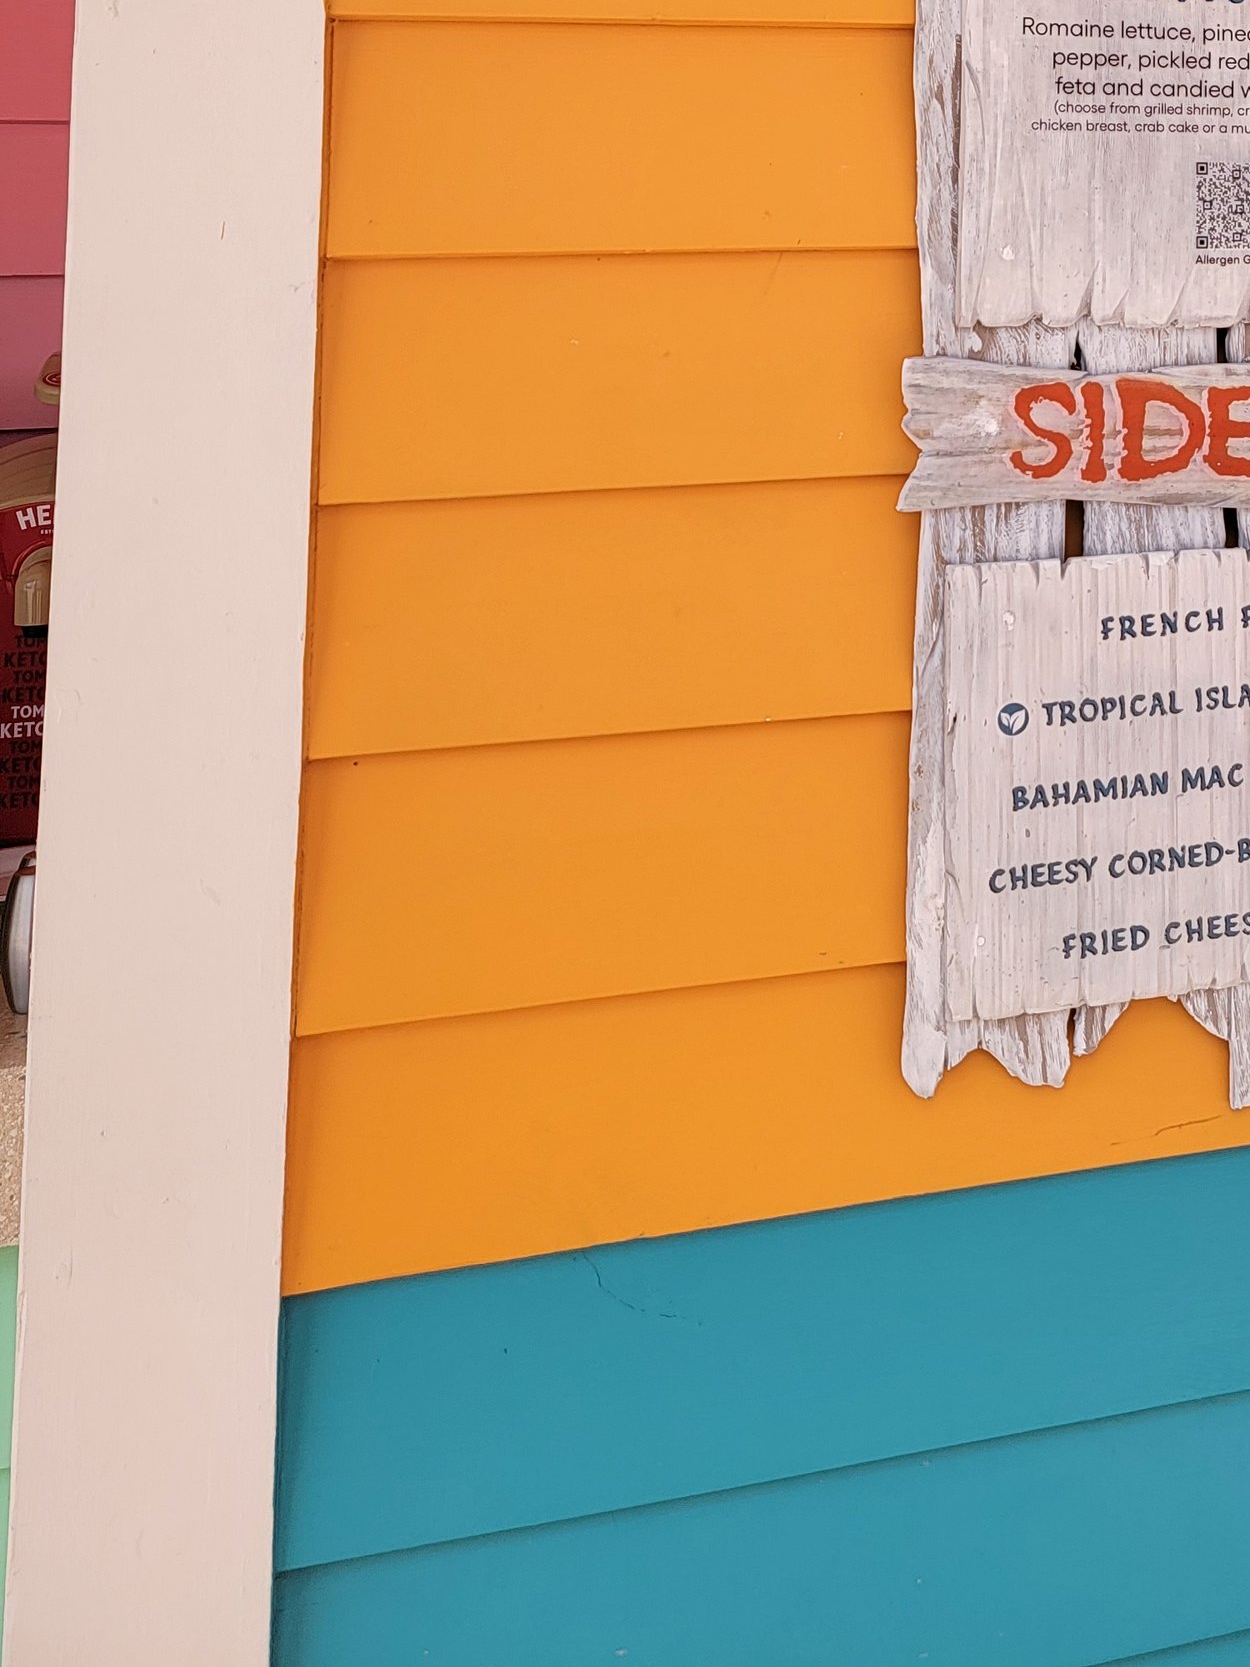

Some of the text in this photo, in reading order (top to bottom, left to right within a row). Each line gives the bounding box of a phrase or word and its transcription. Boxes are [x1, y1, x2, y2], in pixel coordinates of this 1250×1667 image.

[1053, 101, 1106, 115] (choose
[1109, 102, 1141, 114] from
[1143, 102, 1183, 117] grilled
[1186, 103, 1233, 118] shrimp,
[1031, 118, 1082, 131] chicken
[1086, 119, 1131, 133] breast,
[1134, 120, 1165, 133] crab
[1168, 121, 1199, 133] cake
[1202, 124, 1216, 133] or
[1218, 124, 1228, 133] a
[1195, 254, 1240, 266] Allergen
[1100, 607, 1224, 641] FRENCH
[11, 704, 45, 719] TOM
[1041, 690, 1184, 727] TROPICAL
[0, 721, 43, 739] KETC
[1011, 771, 1169, 812] BAHAMIAN
[1181, 763, 1244, 793] MAC
[988, 856, 1098, 894] CHEESY
[1062, 925, 1150, 959] FRIED
